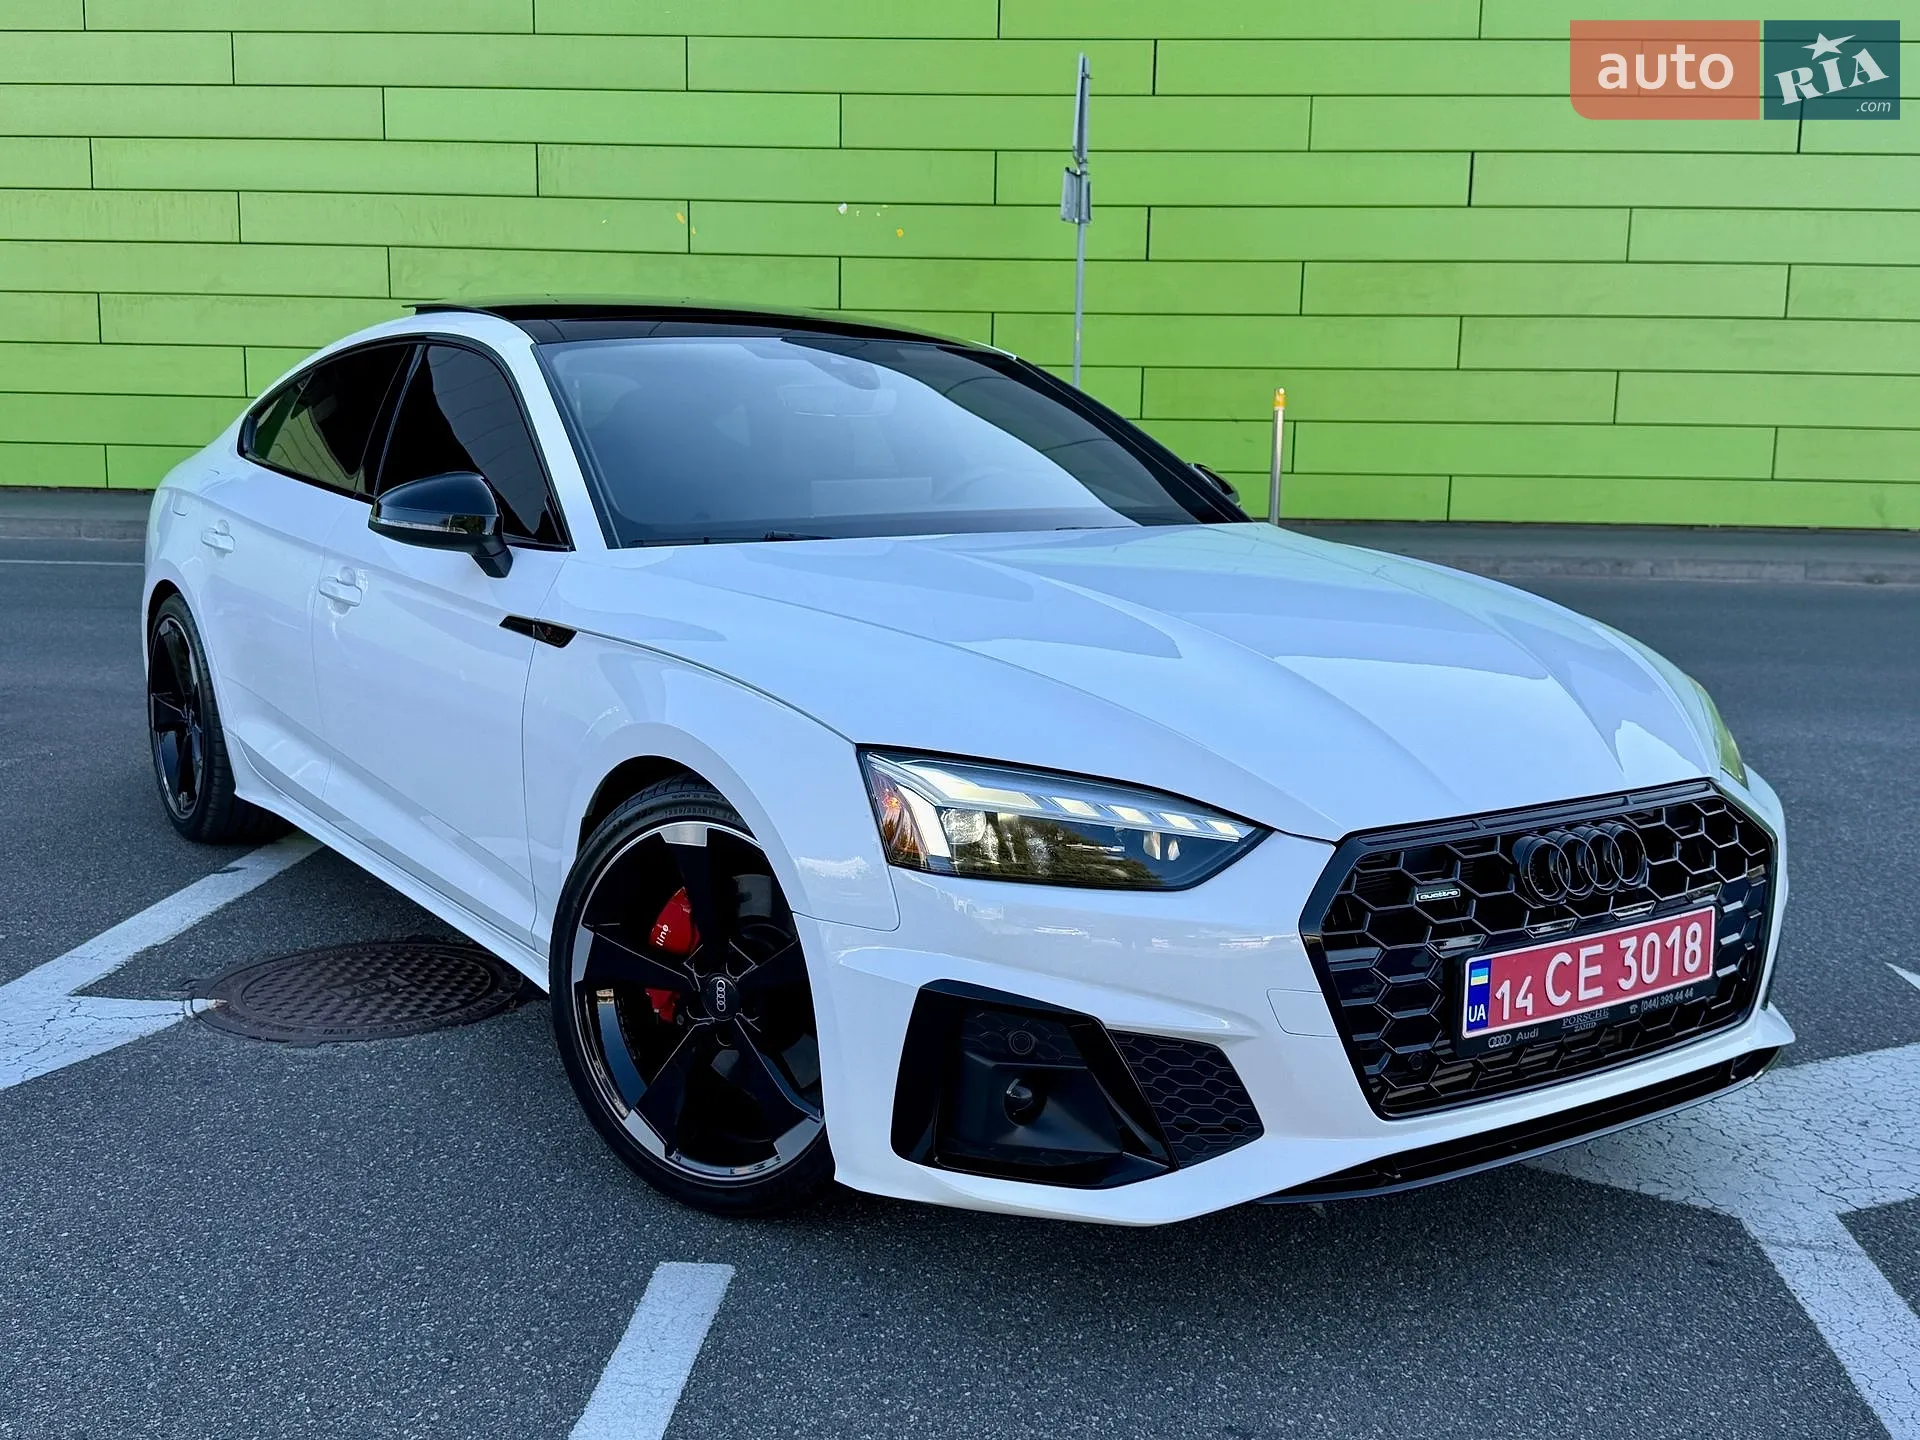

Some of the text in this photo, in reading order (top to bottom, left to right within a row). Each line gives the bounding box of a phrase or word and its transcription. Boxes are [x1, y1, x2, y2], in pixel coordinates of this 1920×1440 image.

[1495, 922, 1703, 1020] 14 CE 3018
[1660, 993, 1674, 1006] 393
[1468, 1004, 1486, 1022] UA
[1561, 1008, 1609, 1027] PORSCHE
[1516, 1028, 1539, 1041] Audi
